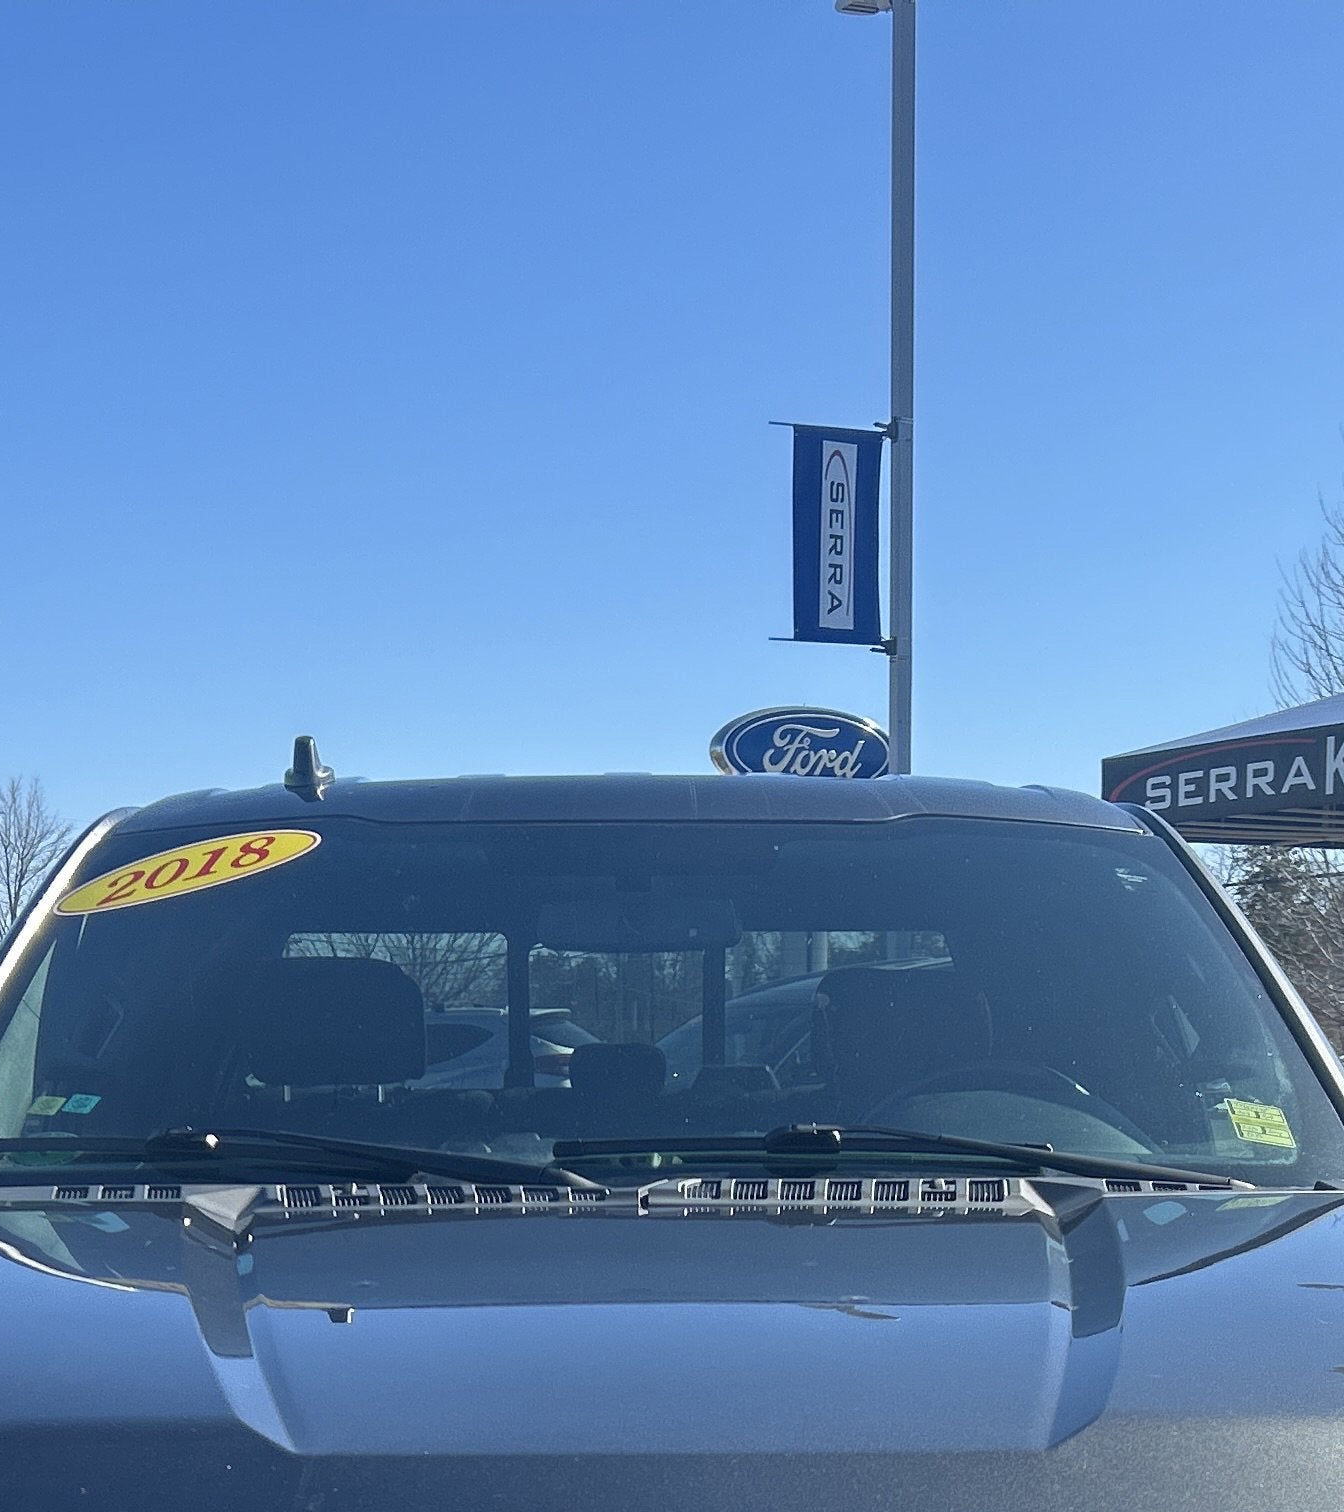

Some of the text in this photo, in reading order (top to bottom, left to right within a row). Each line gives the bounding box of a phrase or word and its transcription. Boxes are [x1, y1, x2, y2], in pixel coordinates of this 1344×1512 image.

[827, 480, 846, 616] SERRA
[762, 723, 866, 779] Ford
[1143, 756, 1317, 811] SERRA
[95, 836, 277, 907] 2018
